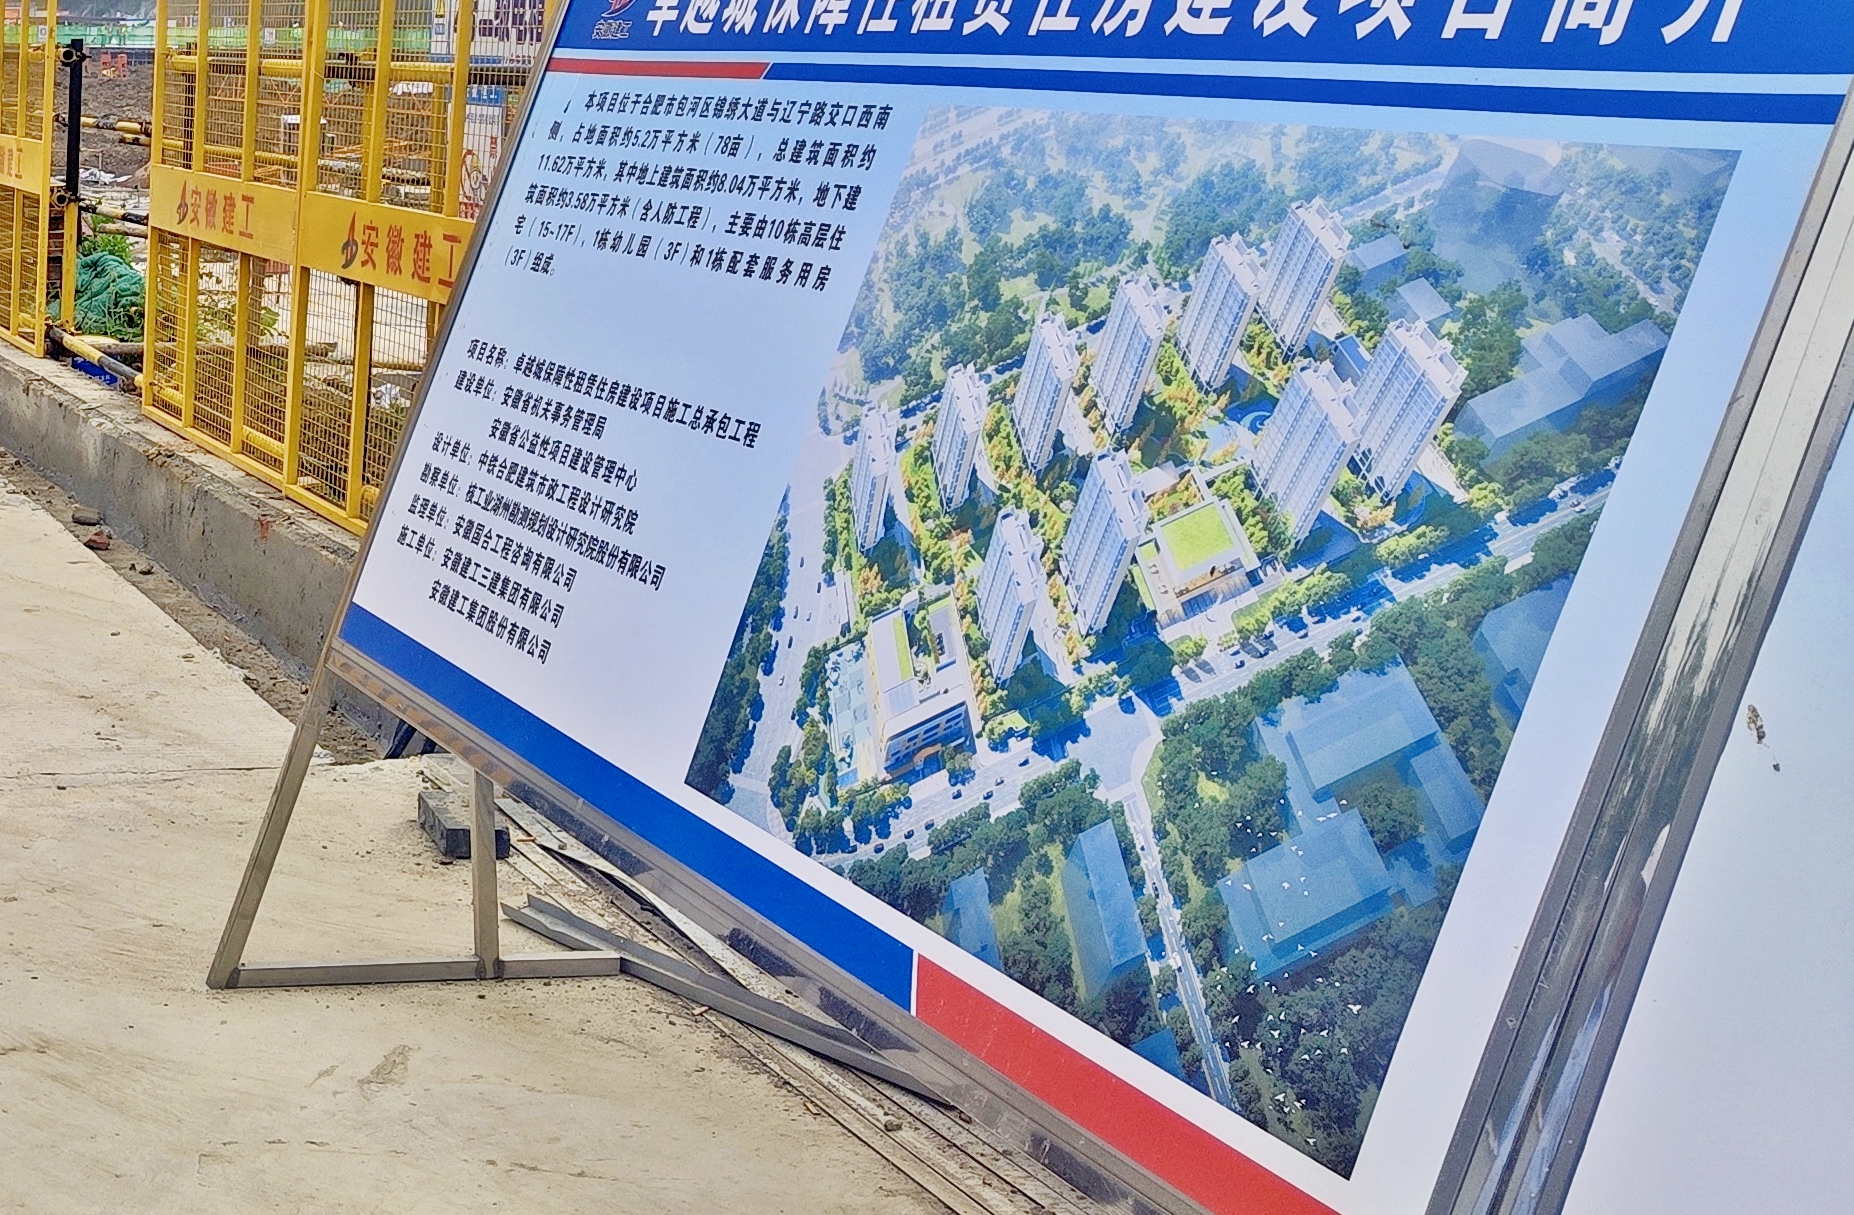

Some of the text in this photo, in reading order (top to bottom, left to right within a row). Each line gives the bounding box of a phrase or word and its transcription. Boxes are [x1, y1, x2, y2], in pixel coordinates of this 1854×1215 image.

[584, 89, 894, 131] 本项目位于合肥市包河区锦绣大道与辽宁路交口西南
[189, 188, 255, 240] 安徽建工
[360, 219, 462, 289] 安徽建工
[428, 578, 552, 665] 安徽建工集团股份有限公司
